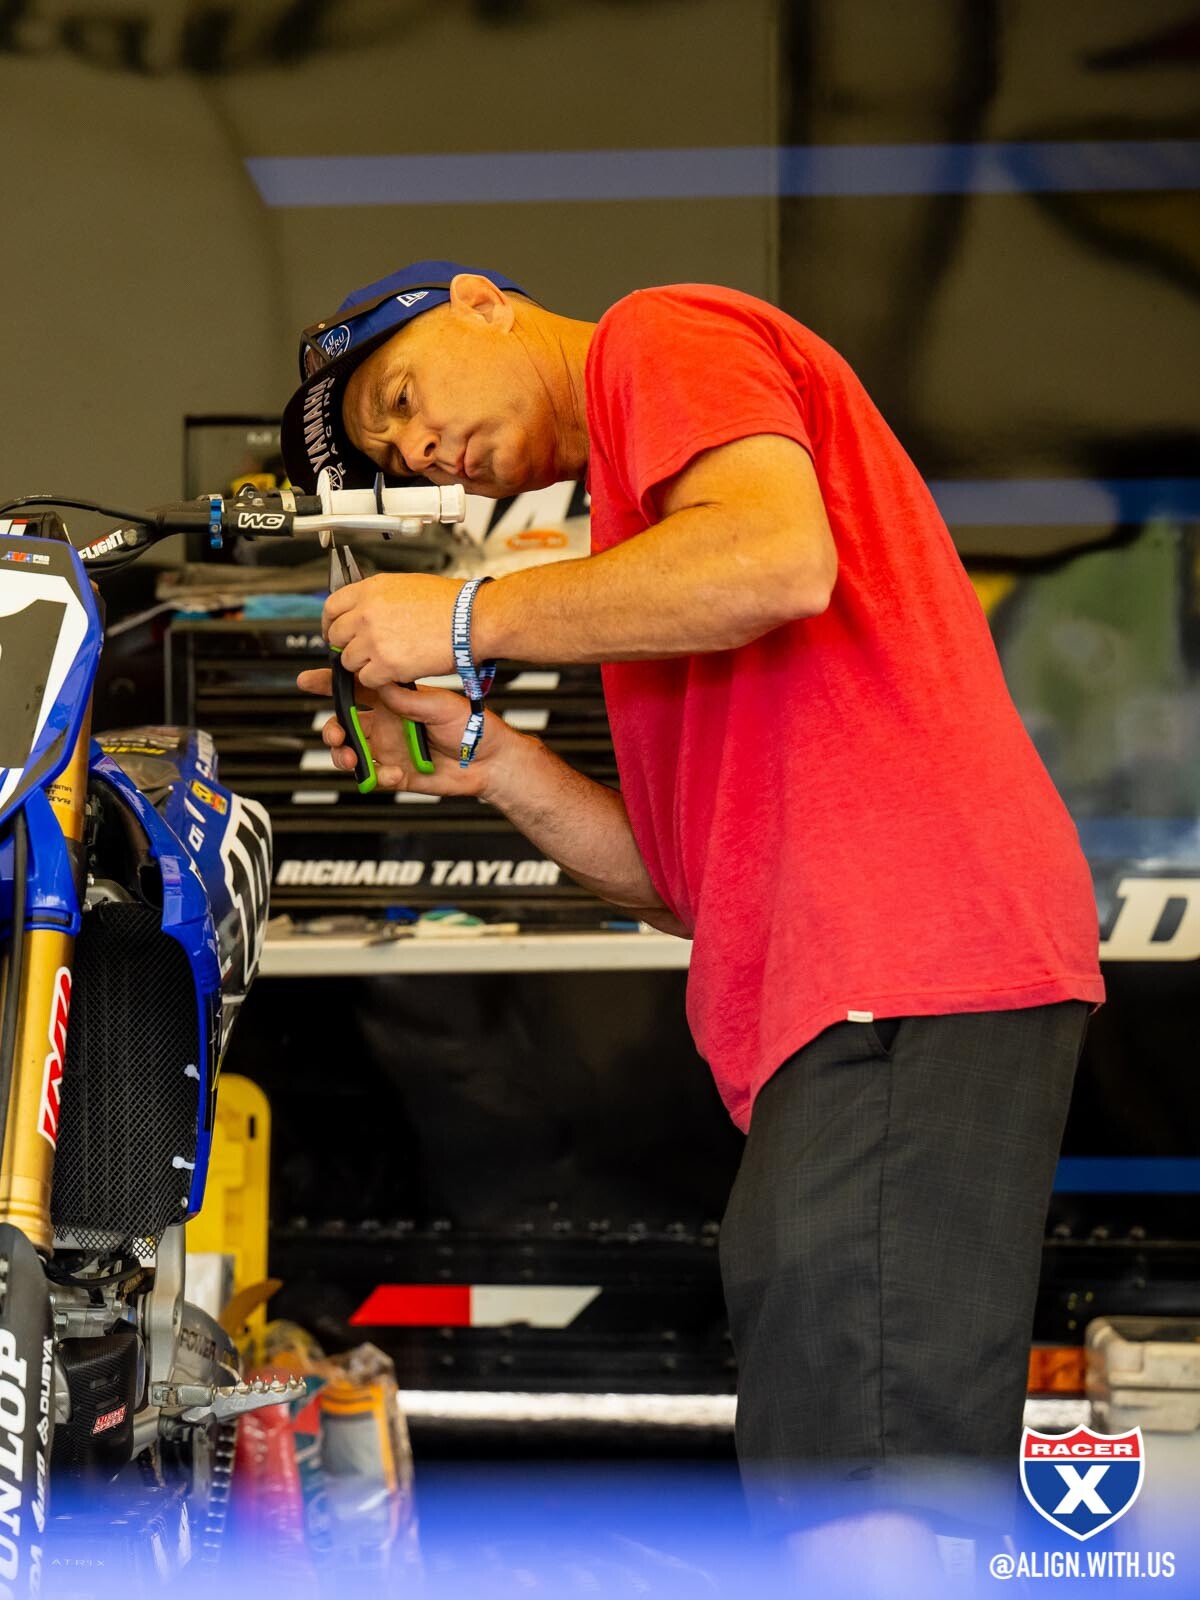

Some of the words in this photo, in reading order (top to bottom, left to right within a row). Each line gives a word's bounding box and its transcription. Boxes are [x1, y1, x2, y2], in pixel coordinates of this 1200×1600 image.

[303, 377, 331, 474] YAMAHA
[275, 860, 424, 886] RICHARD
[430, 860, 561, 886] TAYLOR
